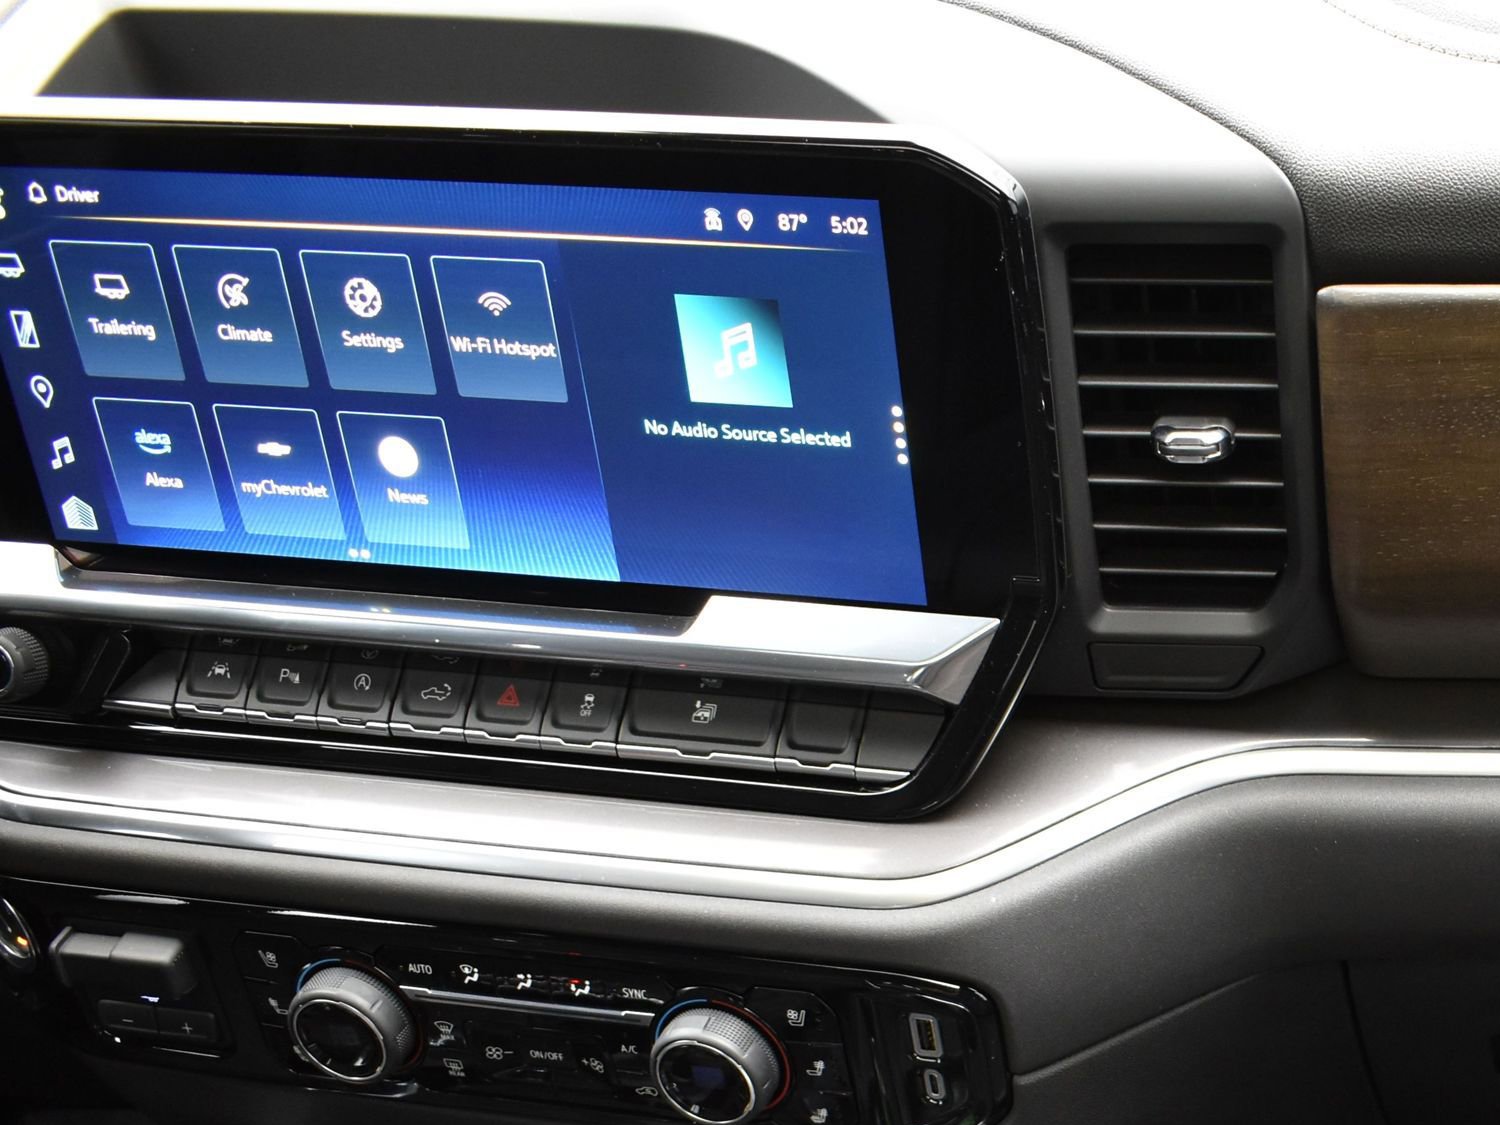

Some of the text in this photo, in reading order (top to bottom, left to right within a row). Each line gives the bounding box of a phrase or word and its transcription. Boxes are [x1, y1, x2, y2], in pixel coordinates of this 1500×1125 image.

[55, 185, 99, 203] Driver
[831, 217, 868, 236] 5:02
[88, 318, 155, 340] Trailering
[218, 325, 272, 342] Climate
[342, 330, 404, 352] Settings
[451, 335, 556, 360] Wi-Fi Hotspot
[644, 419, 851, 448] No Audio Source Selected
[145, 471, 184, 488] Alexa
[241, 480, 328, 499] myChevrolet
[388, 488, 429, 505] News
[408, 964, 432, 974] AUTO
[622, 988, 647, 999] SYNC
[530, 1050, 564, 1062] ON/OFF
[621, 1045, 638, 1054] A/C
